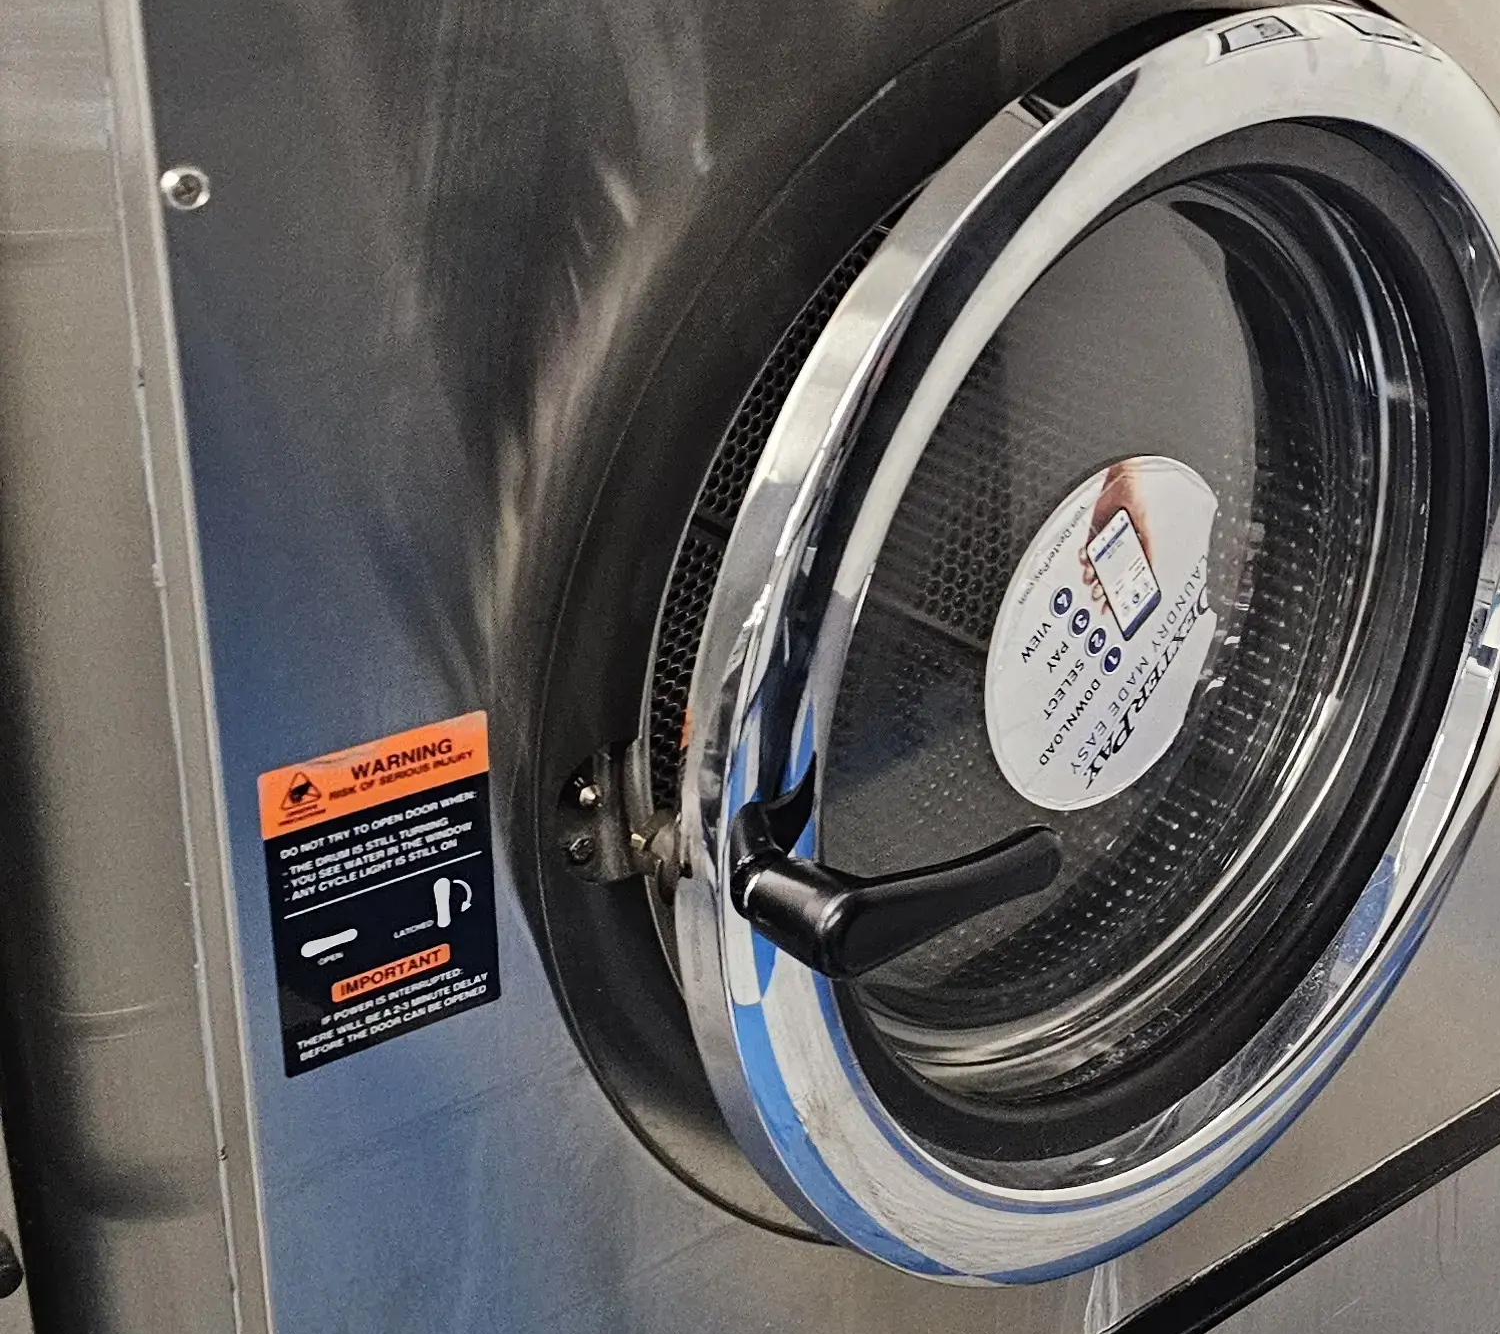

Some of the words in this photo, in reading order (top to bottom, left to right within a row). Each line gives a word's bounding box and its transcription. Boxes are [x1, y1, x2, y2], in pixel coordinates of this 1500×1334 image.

[1022, 622, 1051, 663] VIEW
[1046, 641, 1069, 673] PAY
[1046, 659, 1085, 720] SELECT
[1108, 656, 1150, 717] MADE
[1040, 678, 1100, 765] DOWNLOAD
[1070, 720, 1108, 775] EASY
[329, 784, 357, 800] RISK
[360, 780, 375, 791] OF
[379, 762, 430, 786] SERIOUS
[433, 749, 475, 769] INJURY
[351, 738, 453, 780] WARNING
[279, 846, 298, 859] DO
[299, 837, 325, 853] NOT
[327, 829, 351, 845] TRY
[353, 823, 370, 836] TO
[371, 812, 404, 830] OPEN
[405, 802, 438, 819] DOOR
[289, 860, 314, 875] THE
[315, 848, 350, 866] DRUM
[352, 843, 364, 855] IS
[365, 834, 398, 851] STILL
[399, 817, 449, 839] TURNING
[290, 872, 317, 888] YOU
[318, 863, 341, 879] SEE
[343, 850, 385, 870] WATER
[387, 846, 400, 856] IN
[400, 837, 424, 851] THE
[424, 821, 473, 843] WINDOW
[291, 885, 317, 901] ANY
[318, 871, 359, 892] CYCLE
[359, 861, 393, 878] LIGHT
[394, 857, 406, 867] IS
[407, 847, 439, 862] STILL
[440, 838, 458, 851] ON
[317, 951, 344, 966] OPEN
[340, 949, 442, 996] IMPORTANT
[297, 1029, 335, 1050] THERE
[336, 1020, 364, 1034] WILL
[365, 1012, 381, 1024] BE
[382, 1008, 392, 1018] A
[411, 987, 451, 1007] MINUTE
[452, 972, 489, 992] DELAY
[300, 1037, 345, 1062] BEFORE
[347, 1029, 368, 1043] THE
[370, 1018, 402, 1034] DOOR
[403, 1008, 427, 1022] CAN
[443, 985, 487, 1007] OPENED
[333, 999, 374, 1021] POWER
[375, 994, 387, 1005] IS
